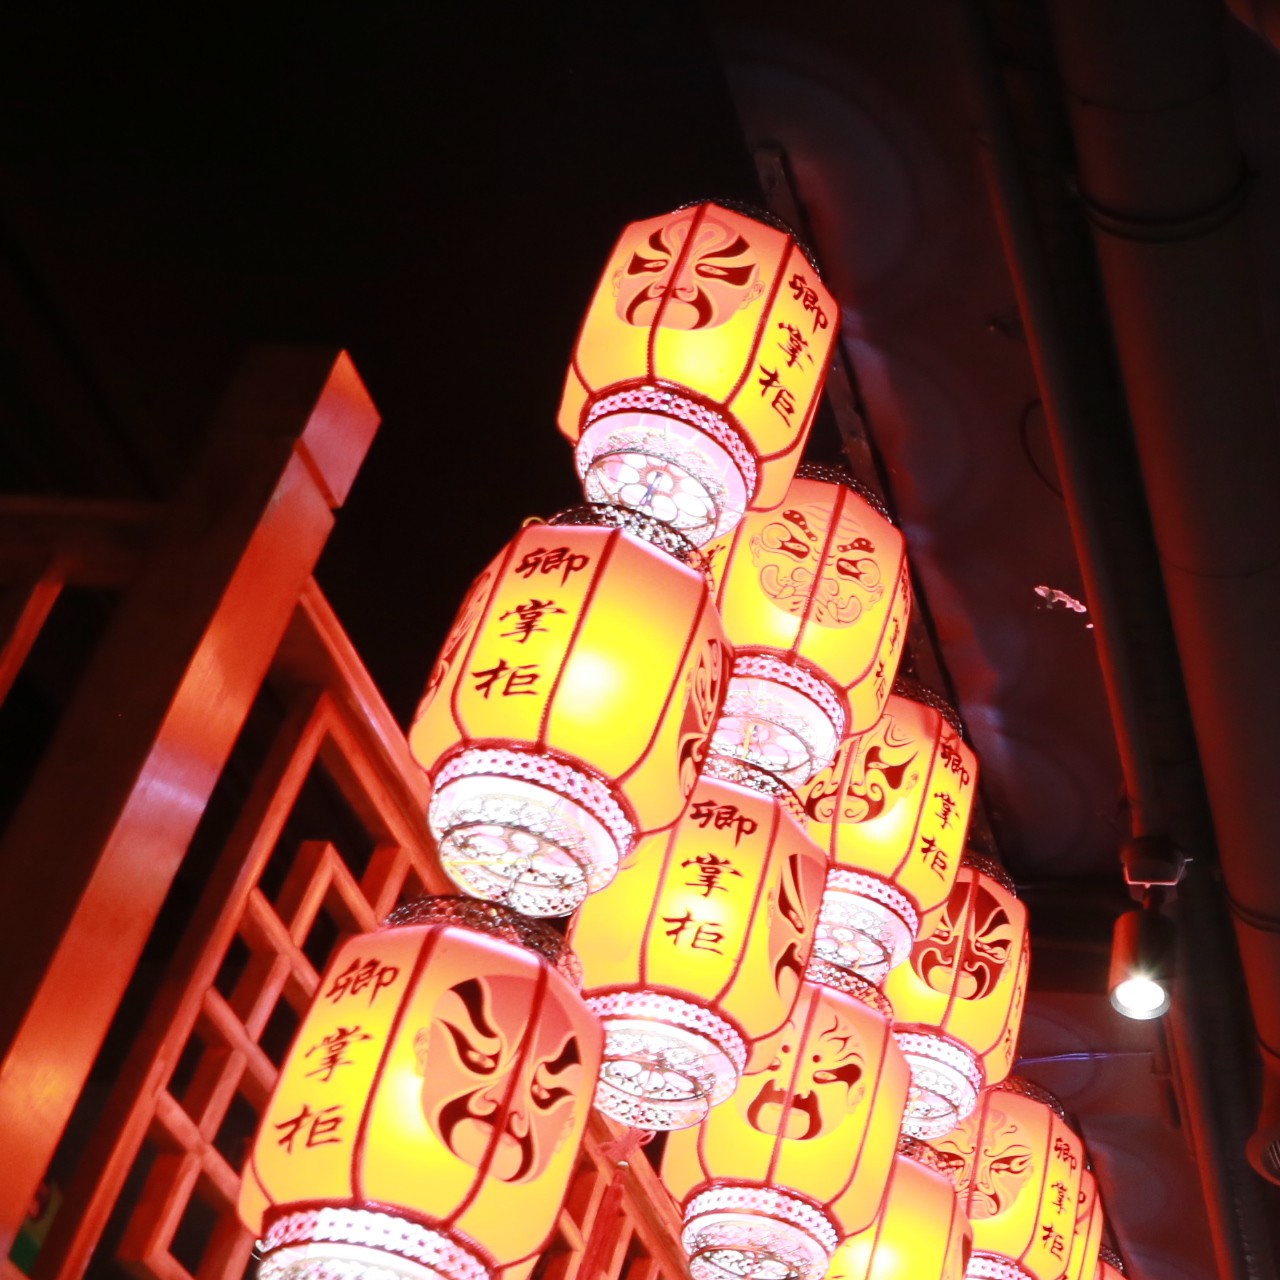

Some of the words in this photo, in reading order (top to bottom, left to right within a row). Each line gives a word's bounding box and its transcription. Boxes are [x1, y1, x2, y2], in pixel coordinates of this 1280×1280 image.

[759, 273, 829, 429] 卿掌柜
[471, 546, 590, 700] 卿掌柜
[662, 799, 758, 956] 卿掌柜
[921, 736, 969, 881] 卿掌柜
[274, 956, 401, 1154] 卿掌柜
[1042, 1137, 1077, 1261] 卿掌柜
